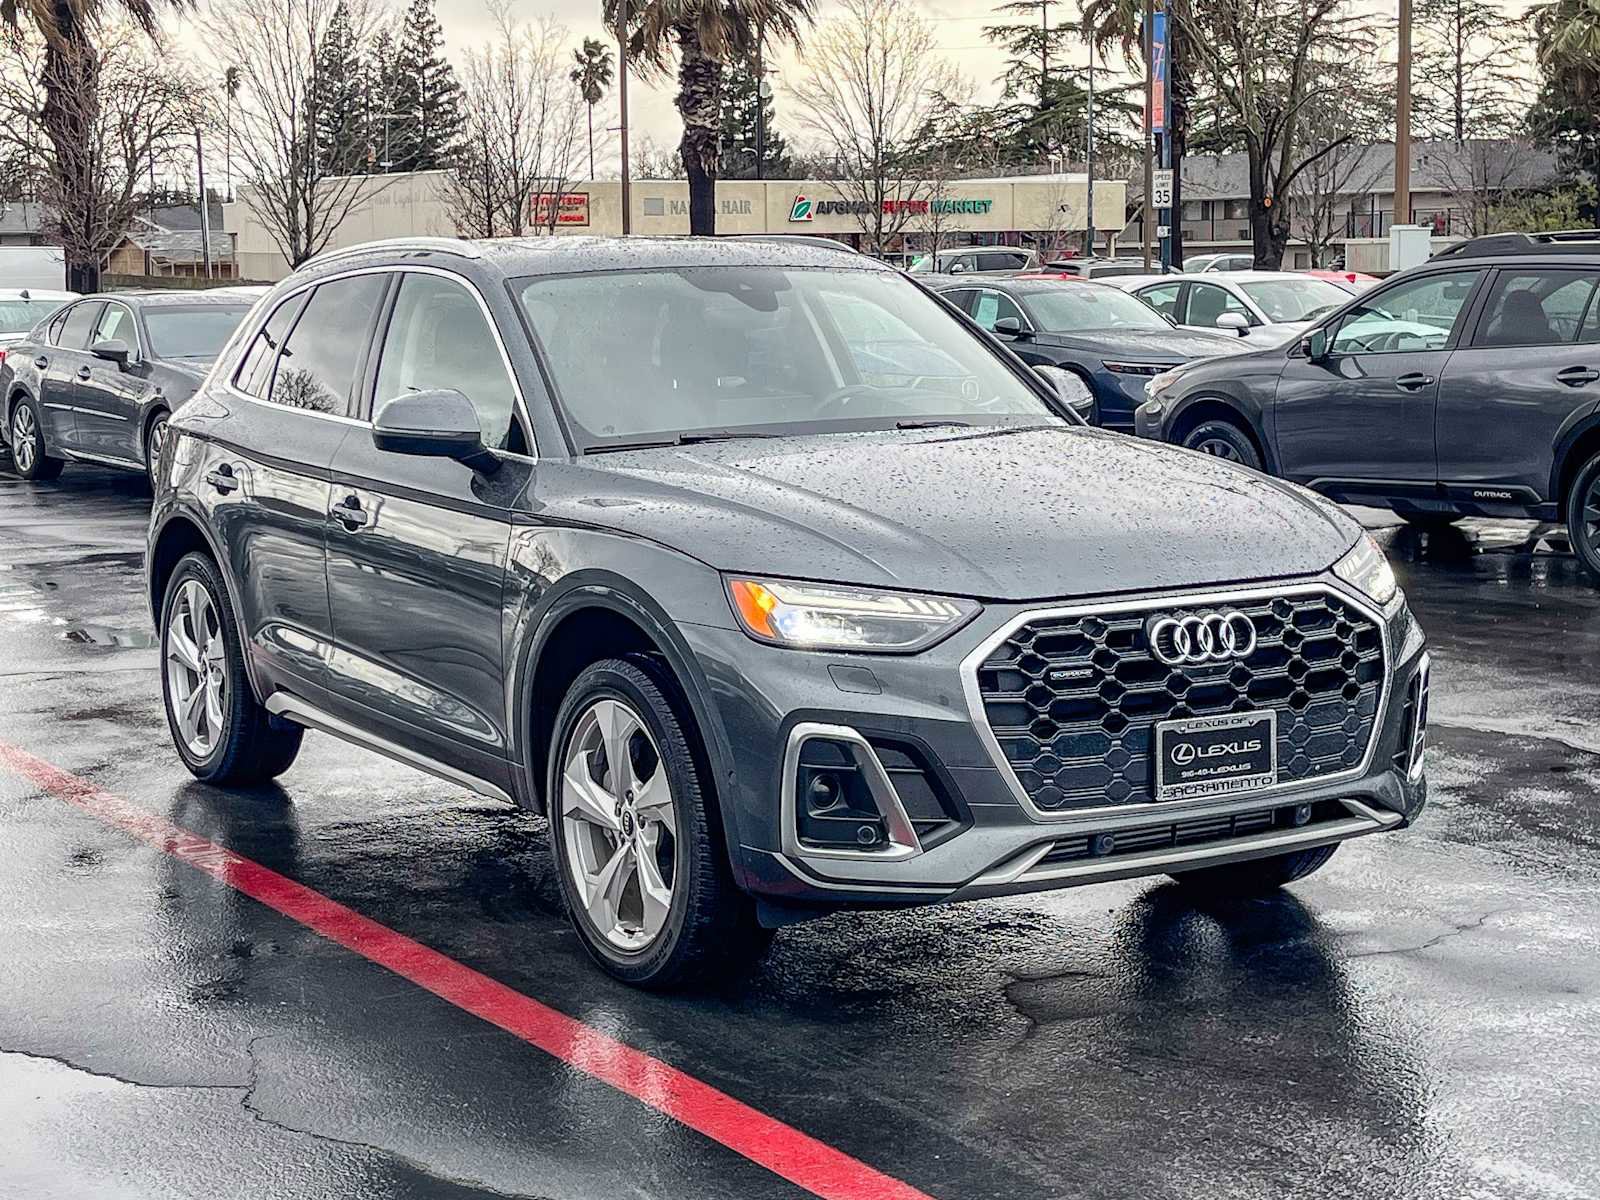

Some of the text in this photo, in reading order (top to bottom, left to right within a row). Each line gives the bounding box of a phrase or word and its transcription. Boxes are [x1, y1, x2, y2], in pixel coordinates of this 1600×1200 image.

[1155, 190, 1170, 204] 35
[721, 200, 752, 215] HAIR
[930, 200, 993, 215] MARKET
[1473, 490, 1512, 499] OUTBACK
[1187, 717, 1247, 730] LEXUS OF
[1197, 739, 1262, 758] LEXUS
[1163, 776, 1273, 797] SACRAMENTO
